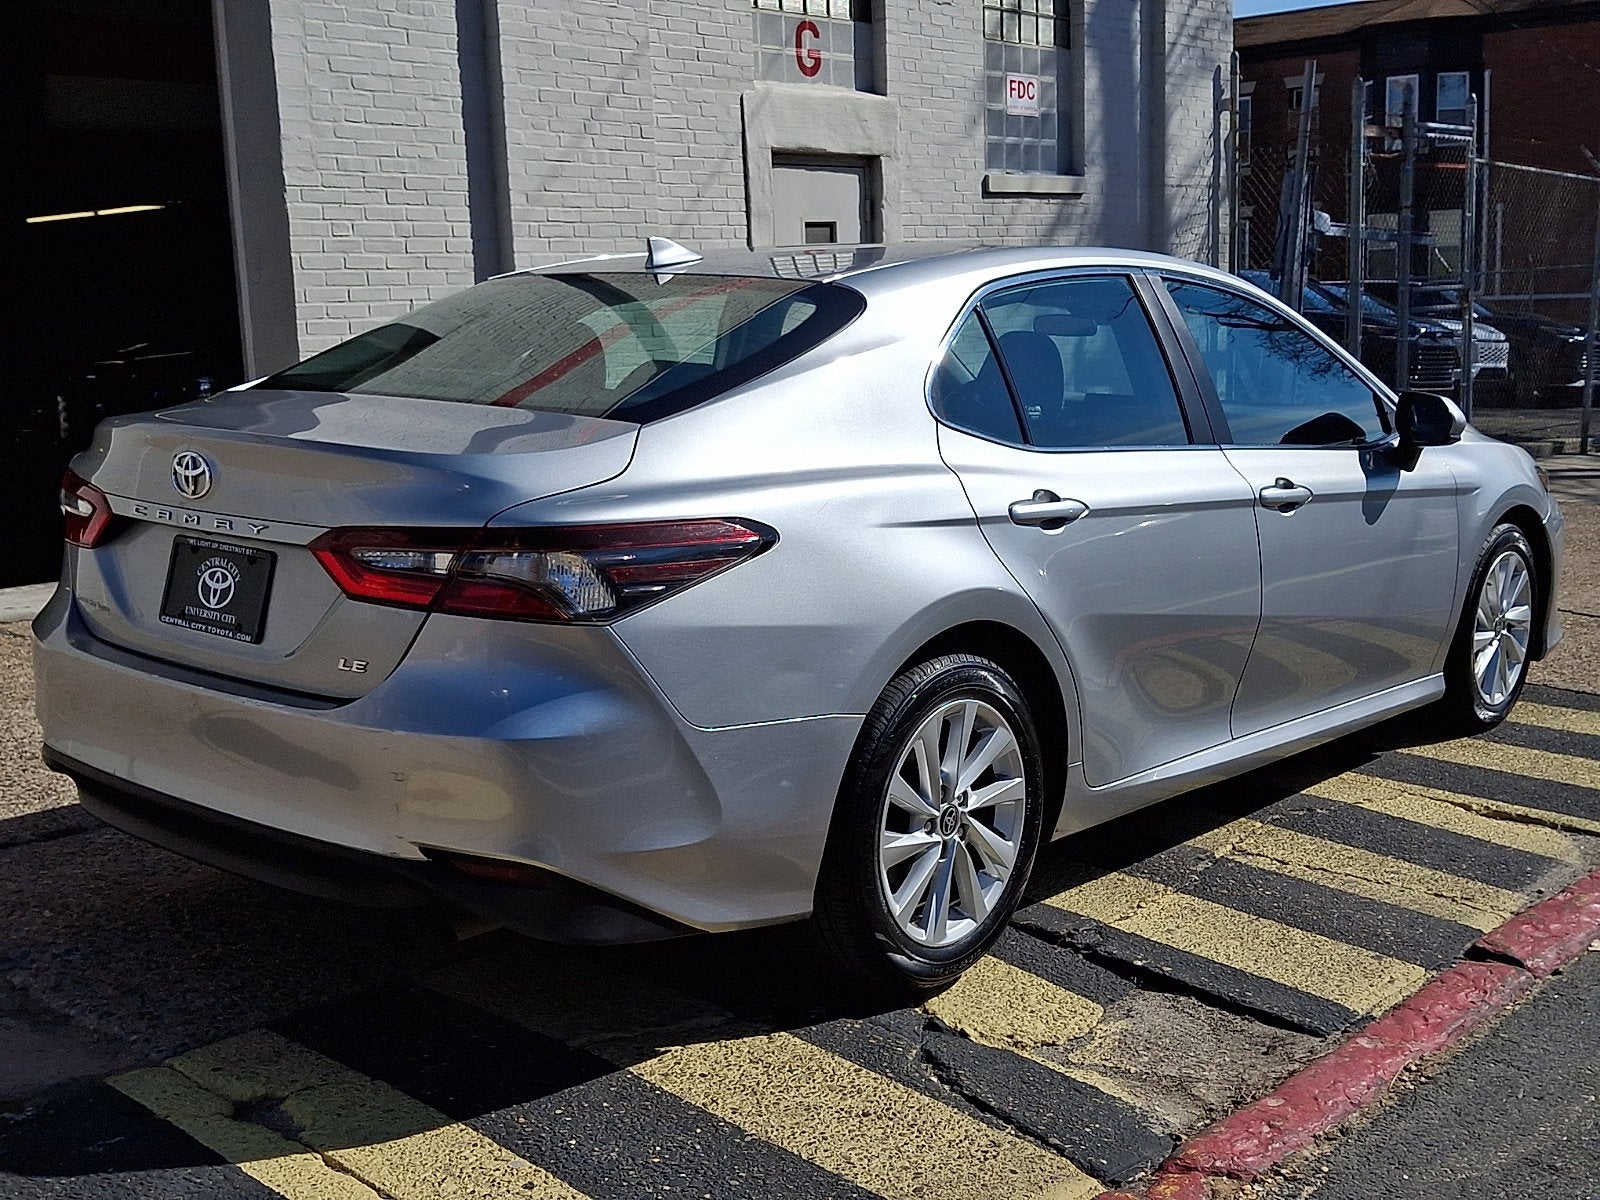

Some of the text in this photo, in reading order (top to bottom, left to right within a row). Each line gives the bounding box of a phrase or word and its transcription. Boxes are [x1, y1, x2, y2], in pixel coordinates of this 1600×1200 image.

[795, 20, 822, 77] G
[1009, 79, 1035, 101] FDC
[133, 504, 269, 535] CAMRY
[197, 539, 212, 548] LIGHT
[219, 543, 246, 555] CHESTNUT
[196, 556, 242, 583] CENTRAL CITY
[185, 605, 236, 625] UNIVERSITY CITY
[160, 615, 190, 628] CENTRAL
[190, 622, 206, 631] CITY
[207, 625, 233, 638] TOYOTA
[338, 657, 369, 674] LE
